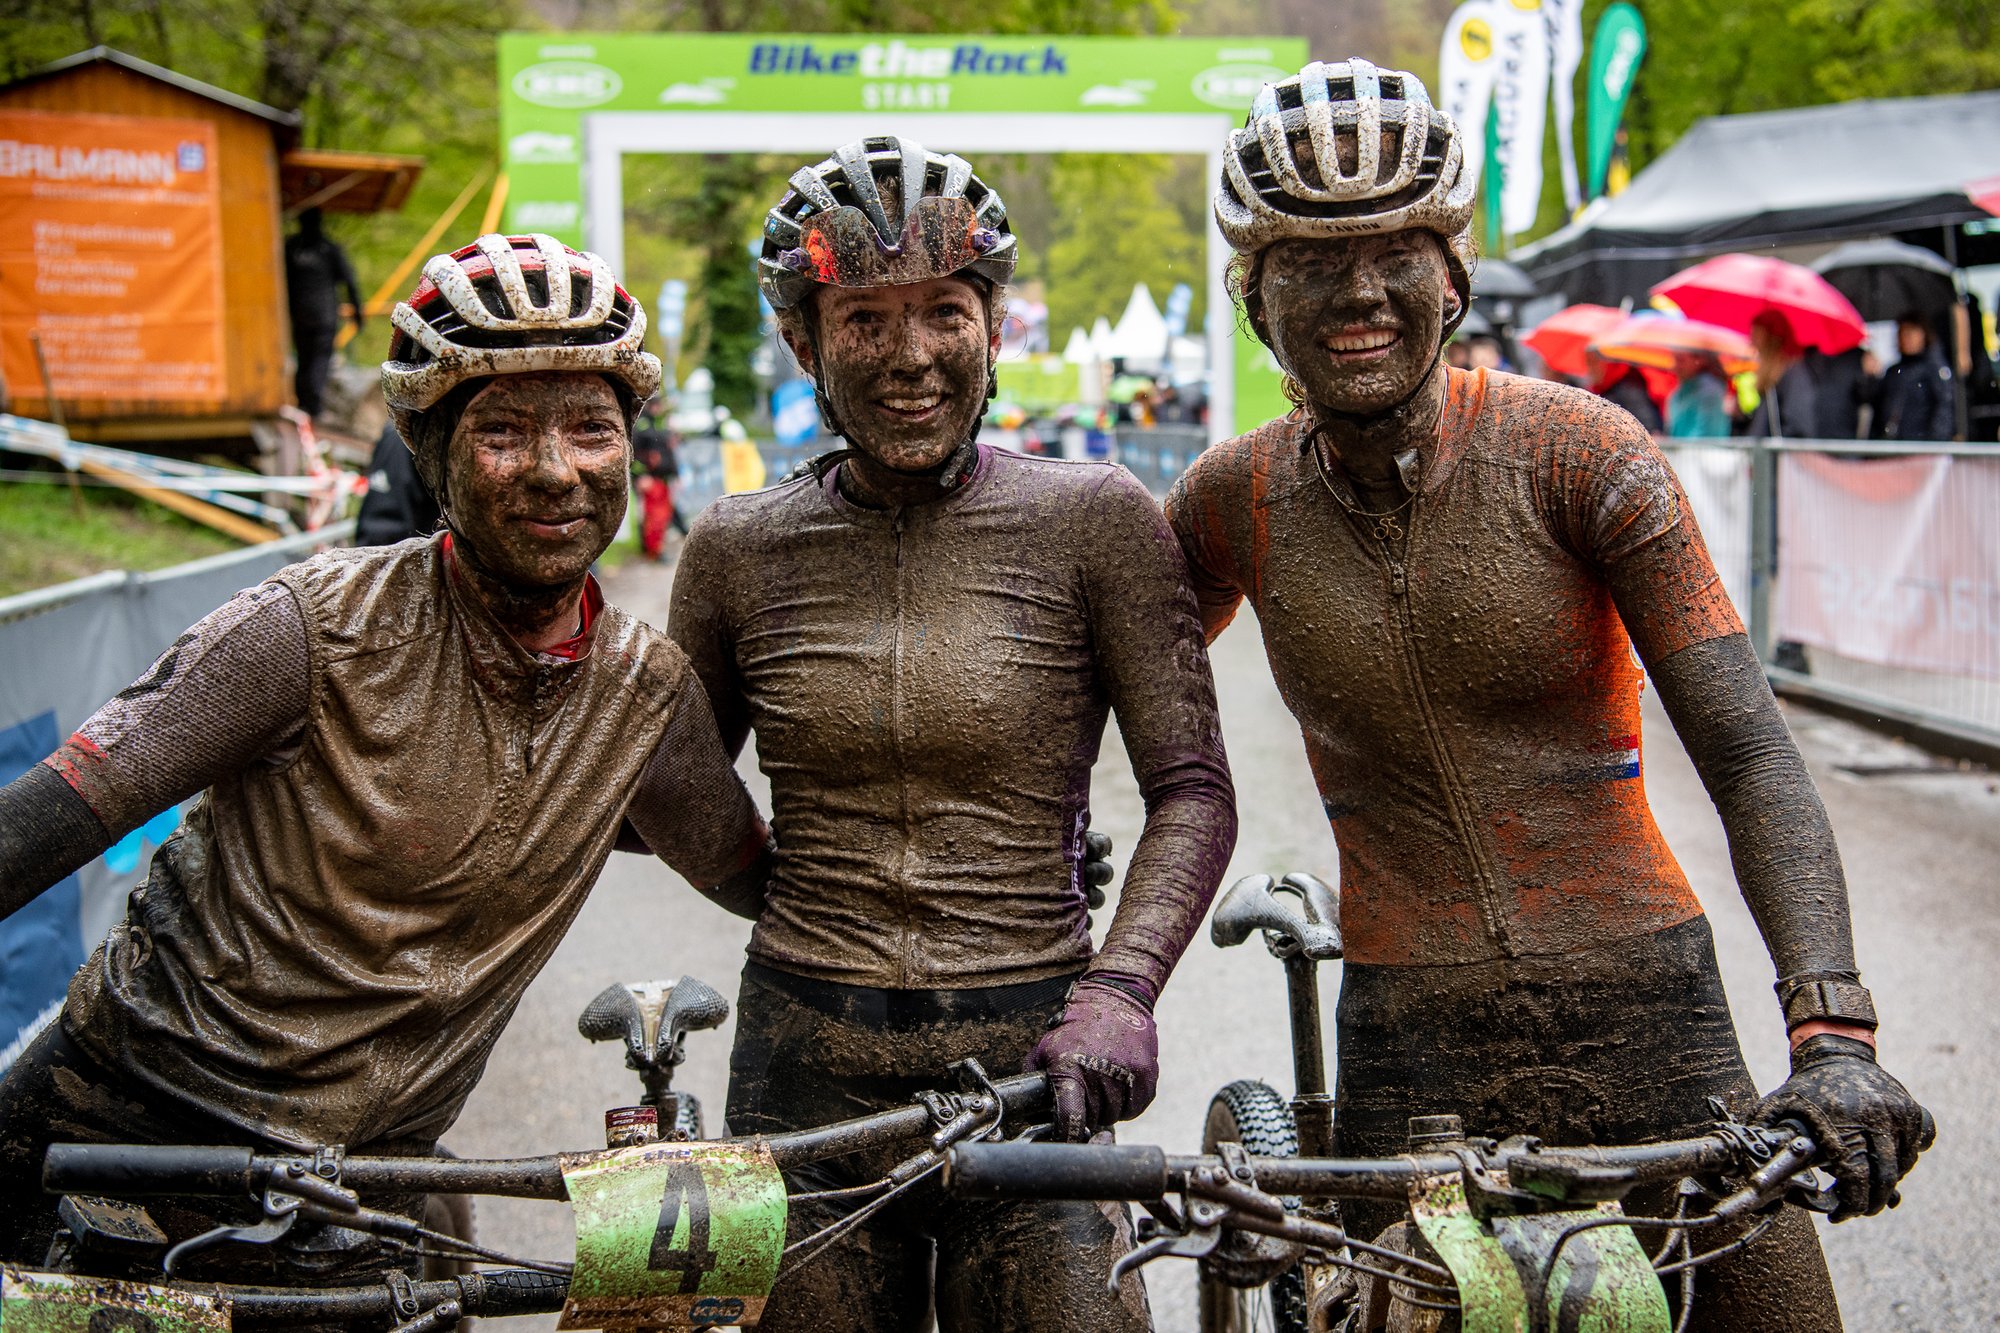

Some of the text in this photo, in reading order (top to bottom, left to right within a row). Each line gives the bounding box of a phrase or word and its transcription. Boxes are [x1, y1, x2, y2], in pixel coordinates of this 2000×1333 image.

[861, 83, 950, 109] START
[0, 139, 175, 185] BAUMANN
[1325, 222, 1382, 233] CANYON
[647, 1163, 718, 1294] 4
